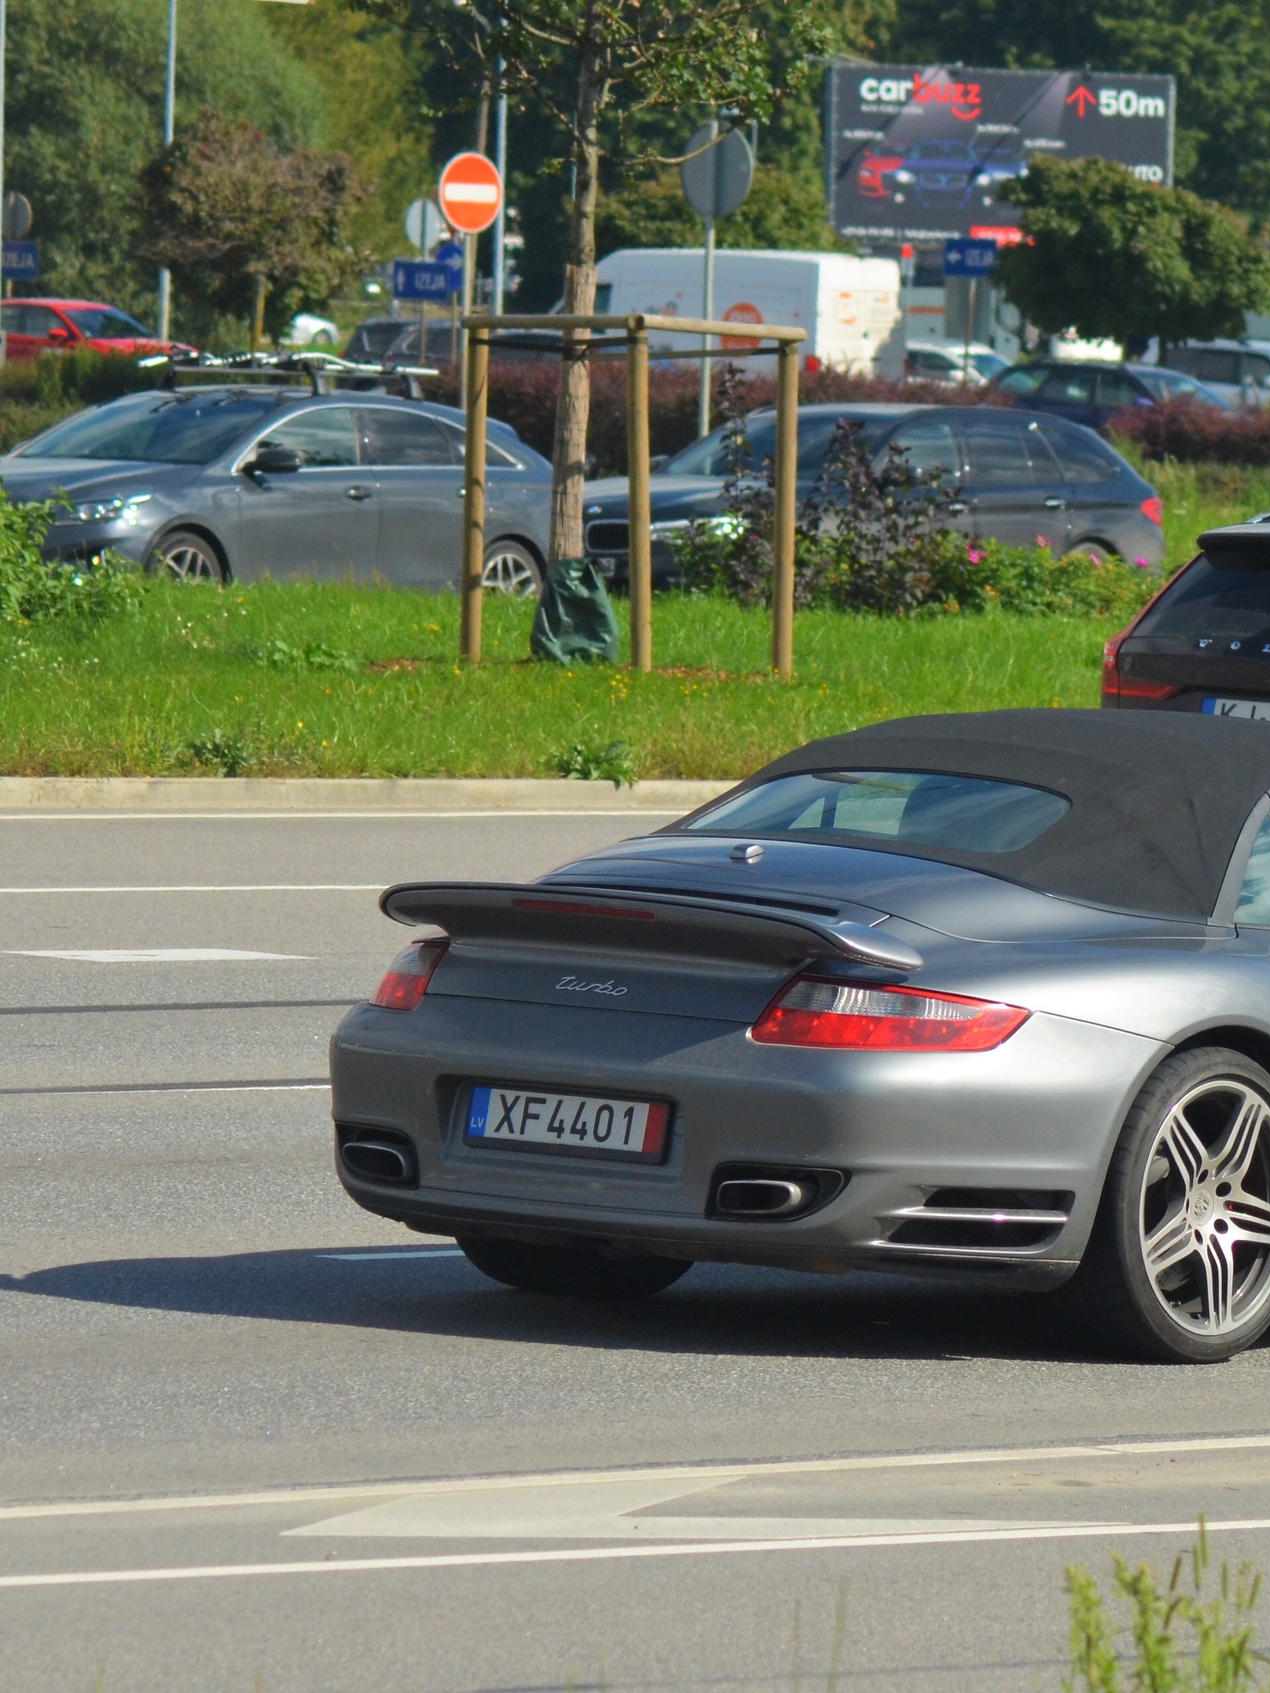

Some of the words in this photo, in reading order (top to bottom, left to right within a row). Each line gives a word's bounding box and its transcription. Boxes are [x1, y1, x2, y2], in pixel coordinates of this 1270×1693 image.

[859, 72, 982, 104] carbuzz
[1098, 89, 1165, 117] 50m
[414, 272, 446, 290] IZEJA
[555, 974, 628, 996] turbo
[470, 1117, 485, 1129] LV
[494, 1094, 635, 1145] XF4401
